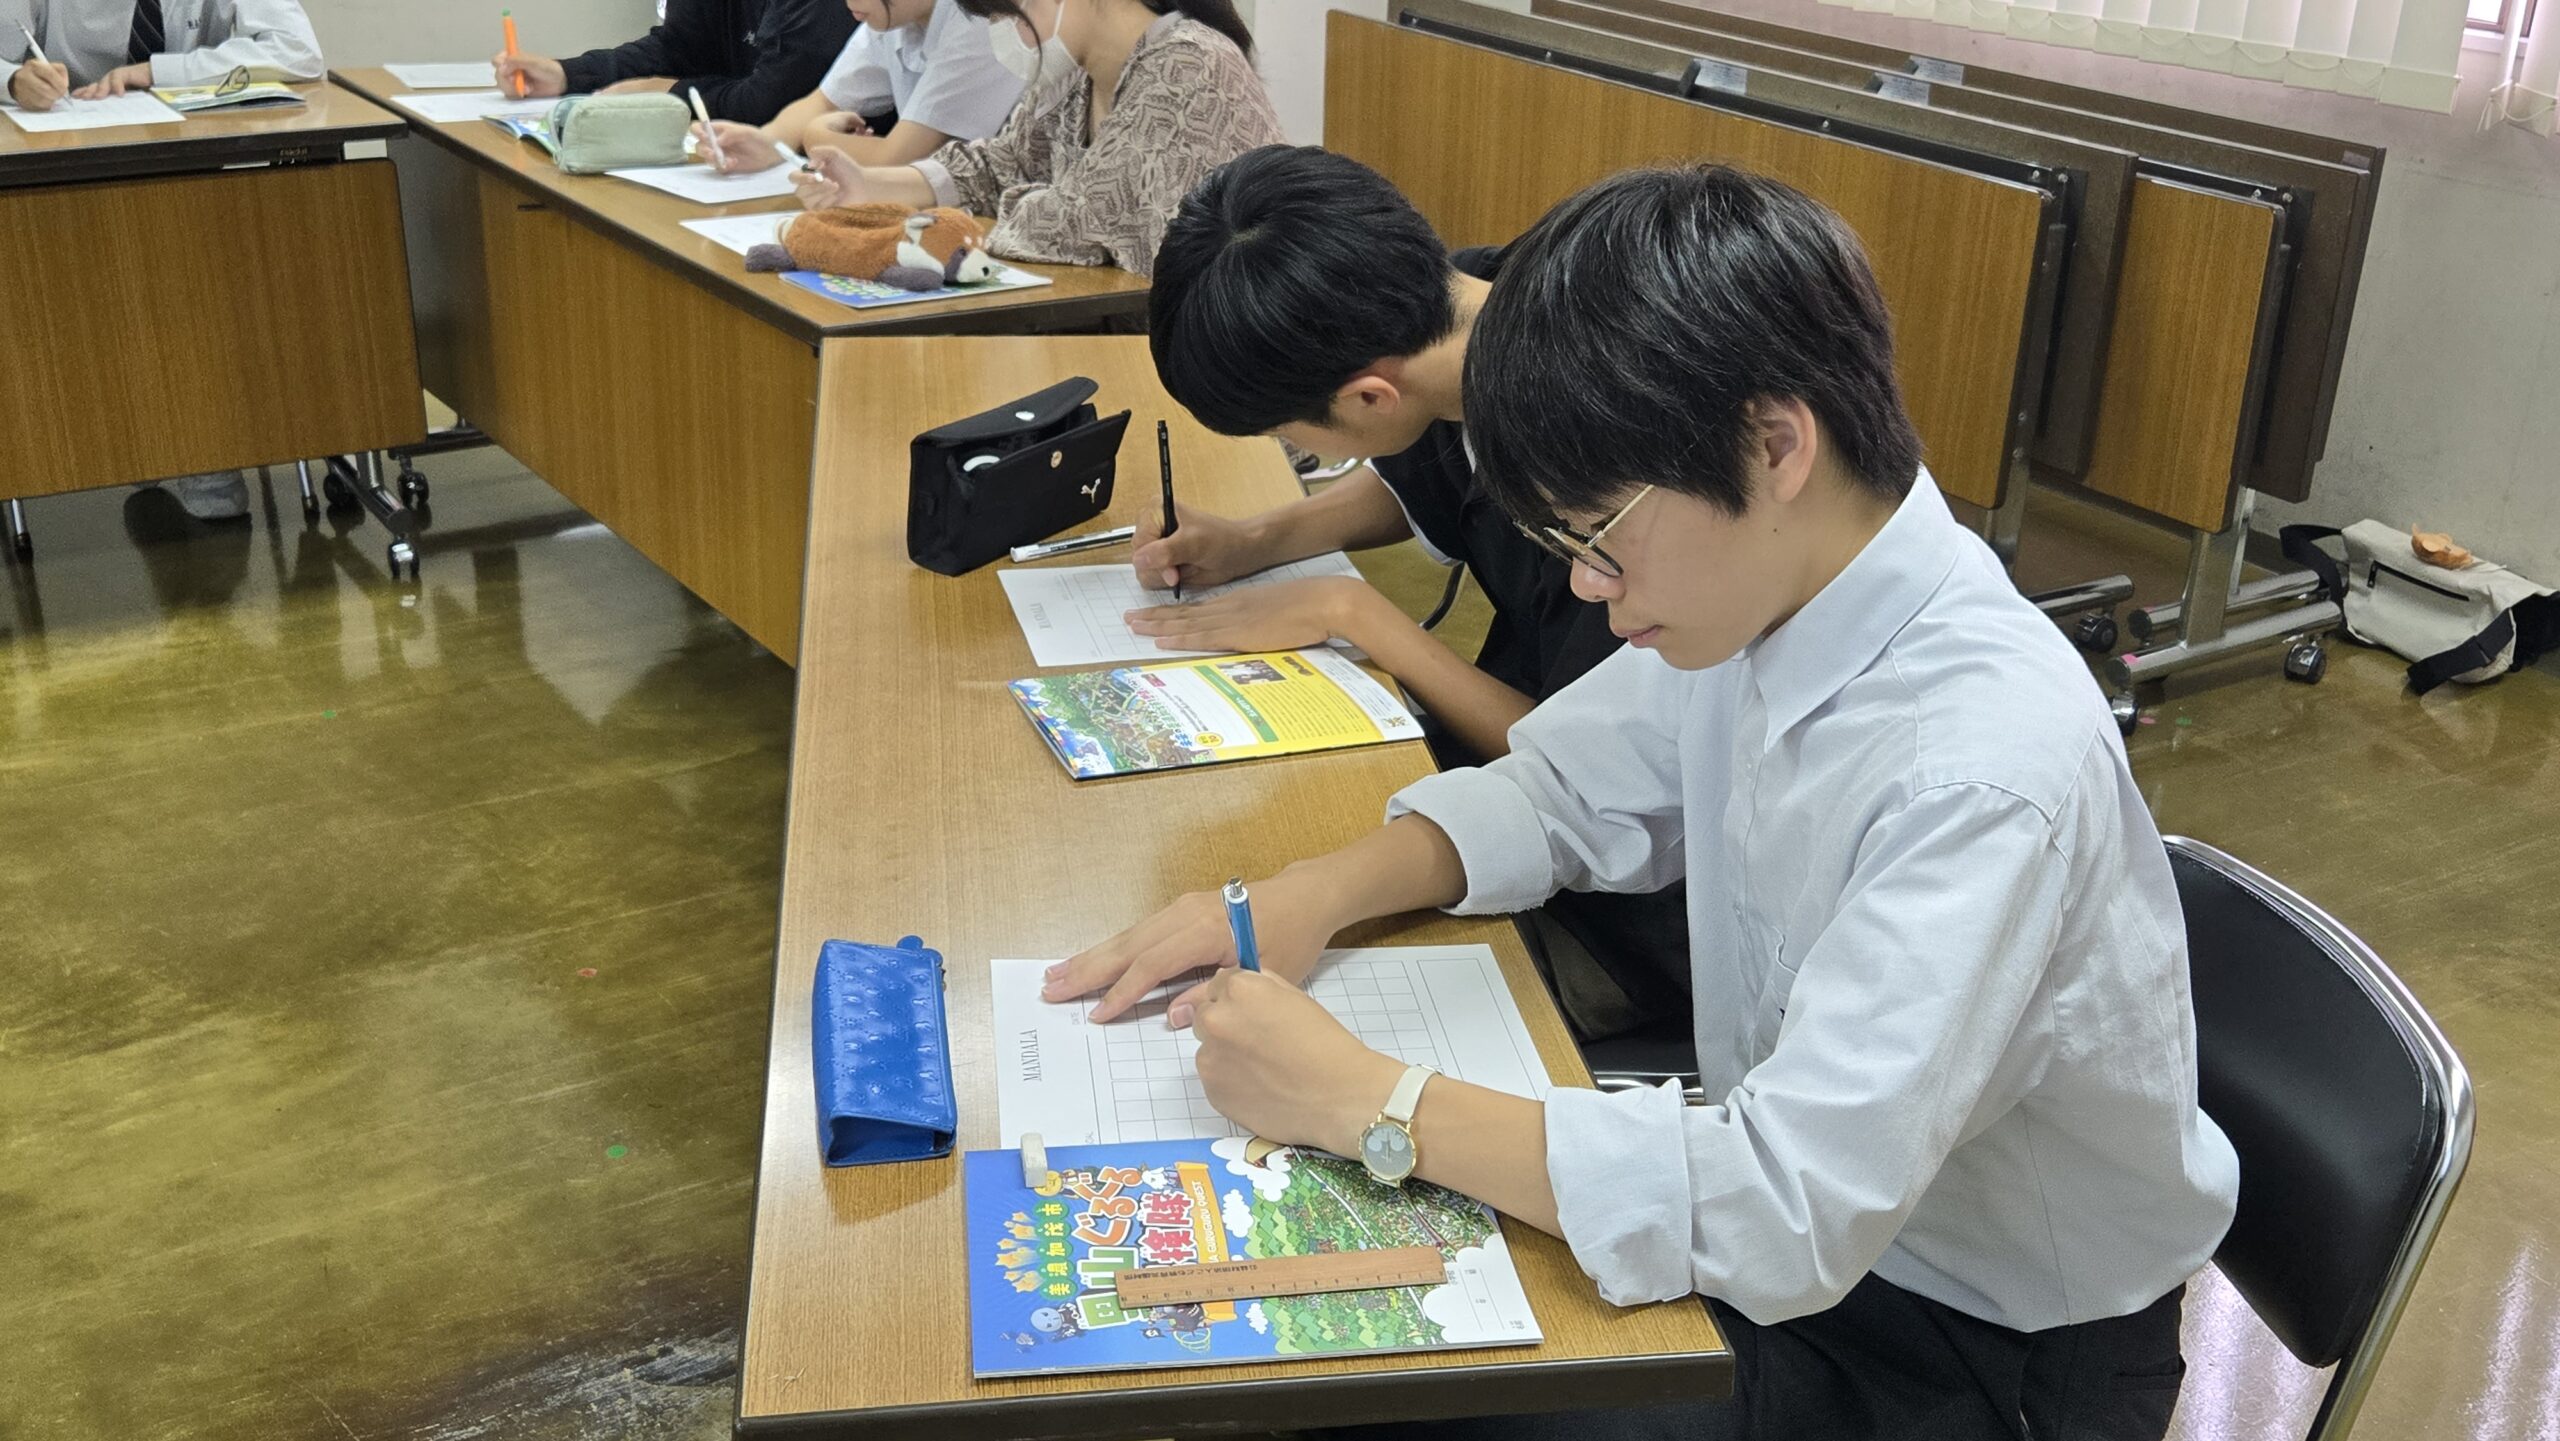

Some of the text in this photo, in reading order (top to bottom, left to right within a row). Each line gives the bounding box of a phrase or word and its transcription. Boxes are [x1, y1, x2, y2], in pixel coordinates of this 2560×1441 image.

[1019, 1028, 1042, 1082] MANDALA
[1192, 1180, 1210, 1207] QUEST
[1043, 1202, 1071, 1297] 美濃加茂市
